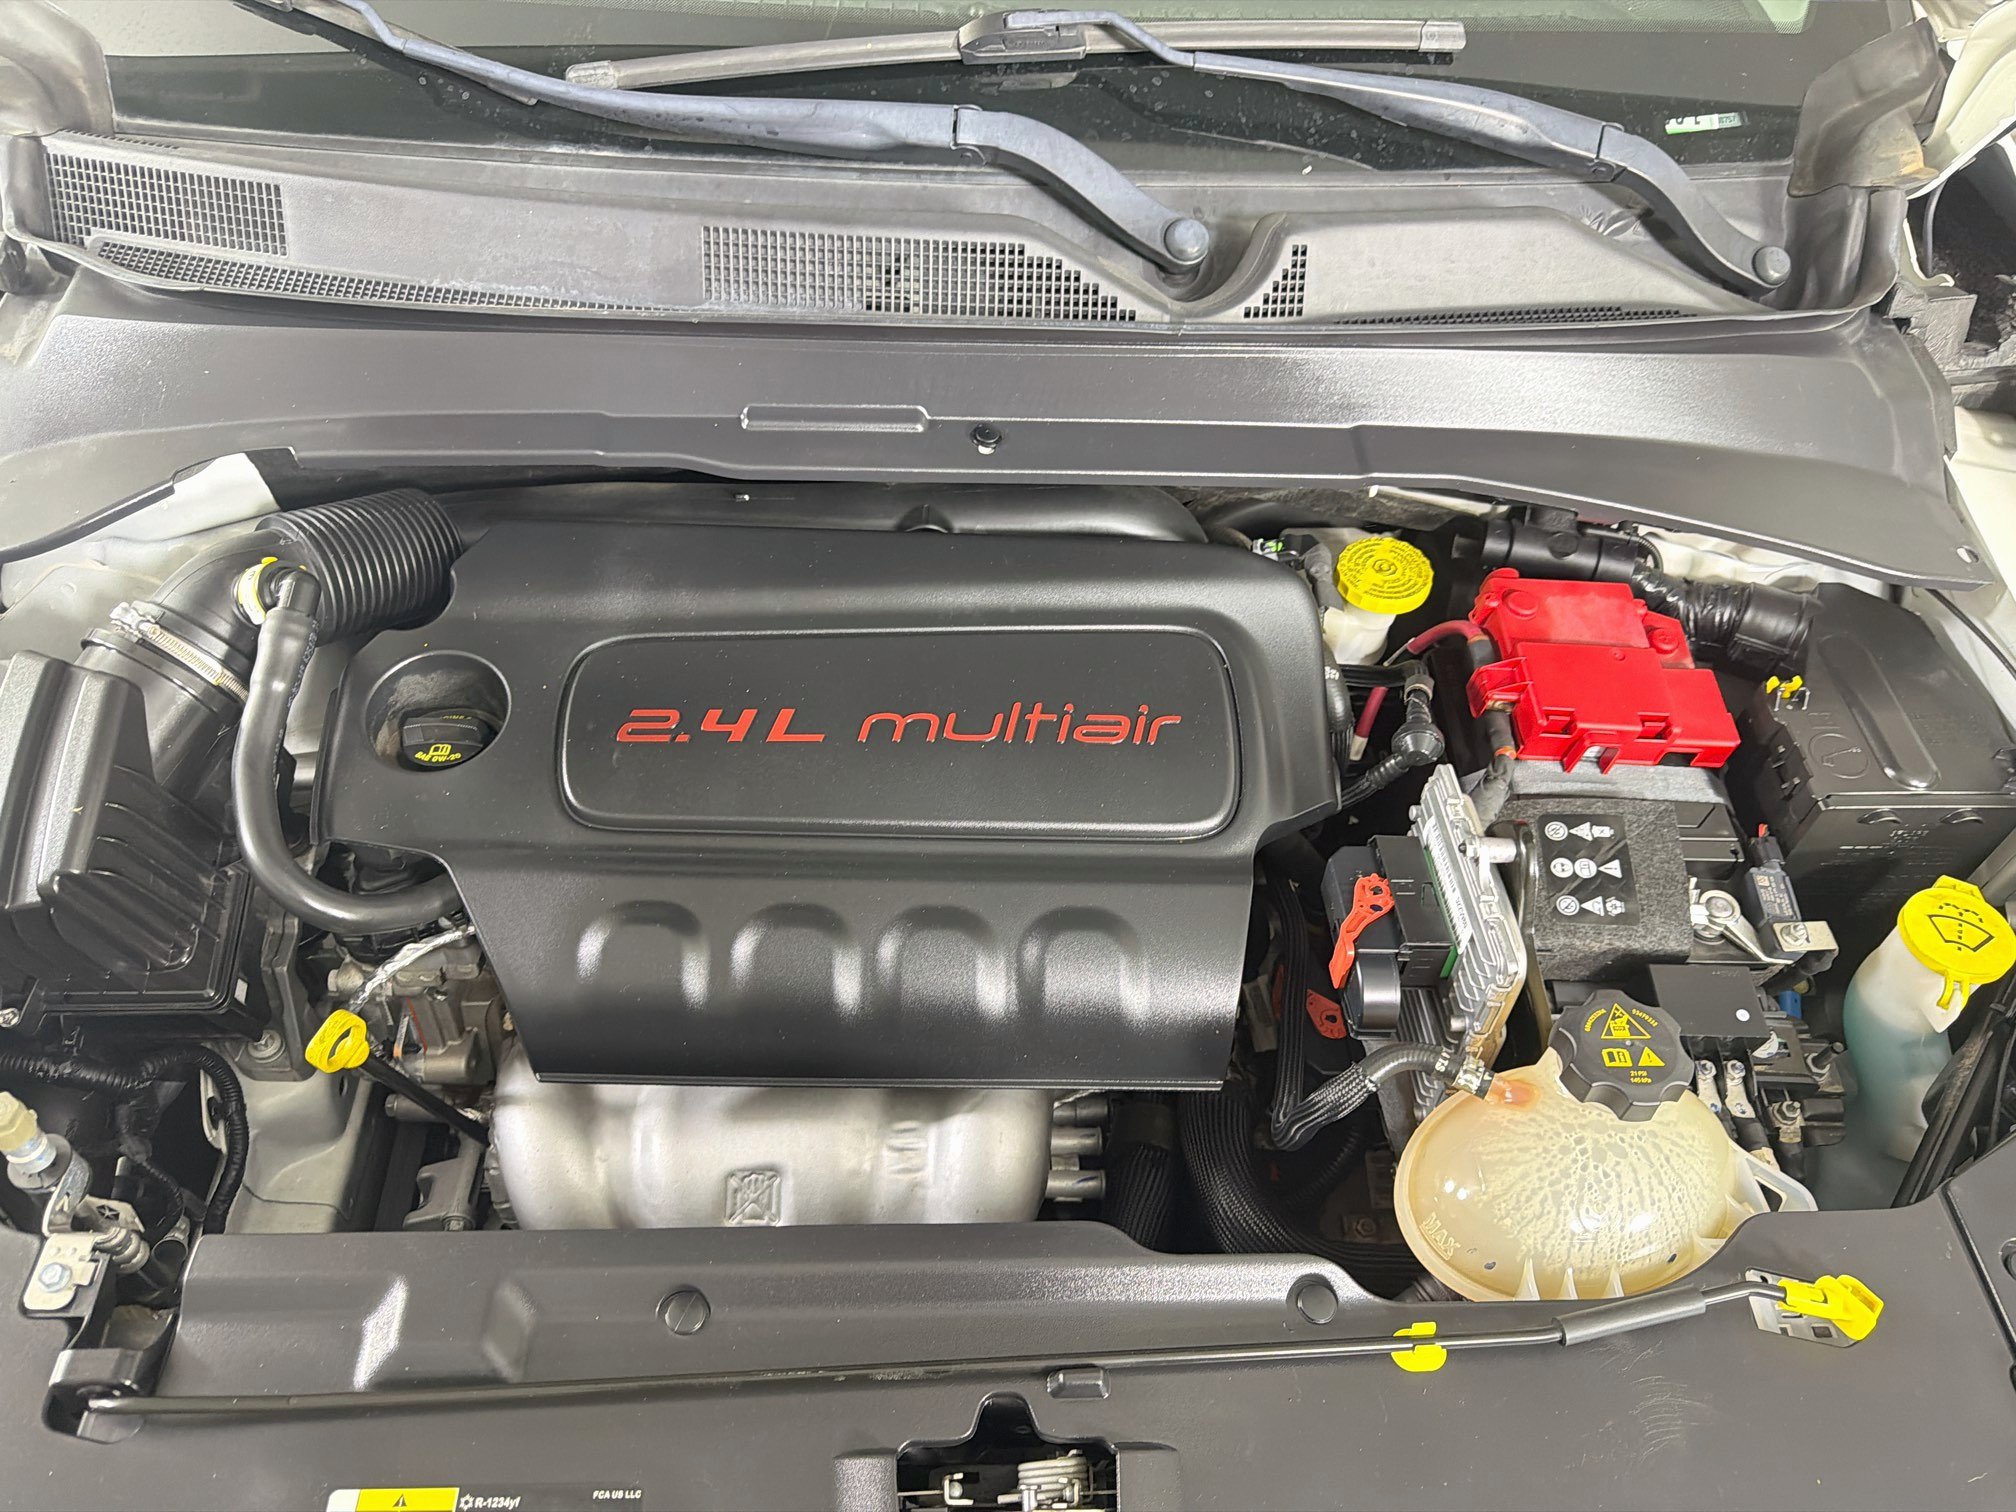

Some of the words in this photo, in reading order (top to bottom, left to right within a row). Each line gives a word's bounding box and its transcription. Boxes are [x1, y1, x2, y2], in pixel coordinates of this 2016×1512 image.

[616, 708, 825, 742] 2.4L
[857, 702, 1182, 745] multiair
[1421, 1211, 1461, 1257] MAX
[593, 1490, 610, 1500] FCA
[624, 1489, 642, 1499] LLC
